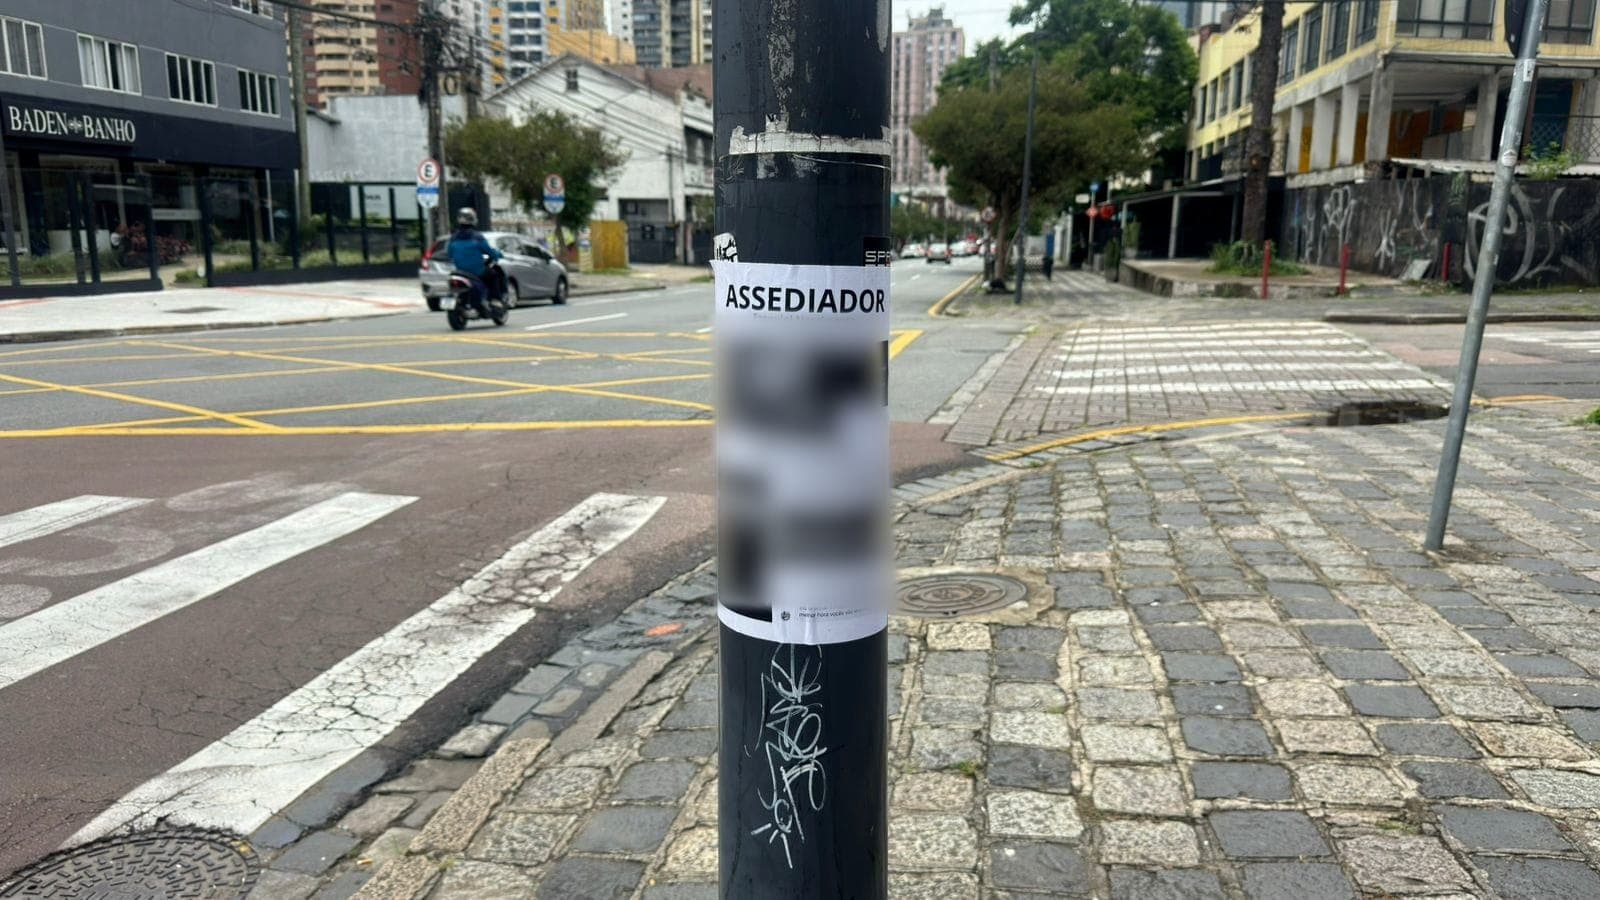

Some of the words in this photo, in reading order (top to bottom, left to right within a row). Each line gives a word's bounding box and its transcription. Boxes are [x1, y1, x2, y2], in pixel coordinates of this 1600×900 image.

[8, 105, 69, 135] BADEN
[82, 114, 136, 143] BANHO
[424, 163, 433, 178] E
[726, 284, 885, 314] ASSEDIADOR
